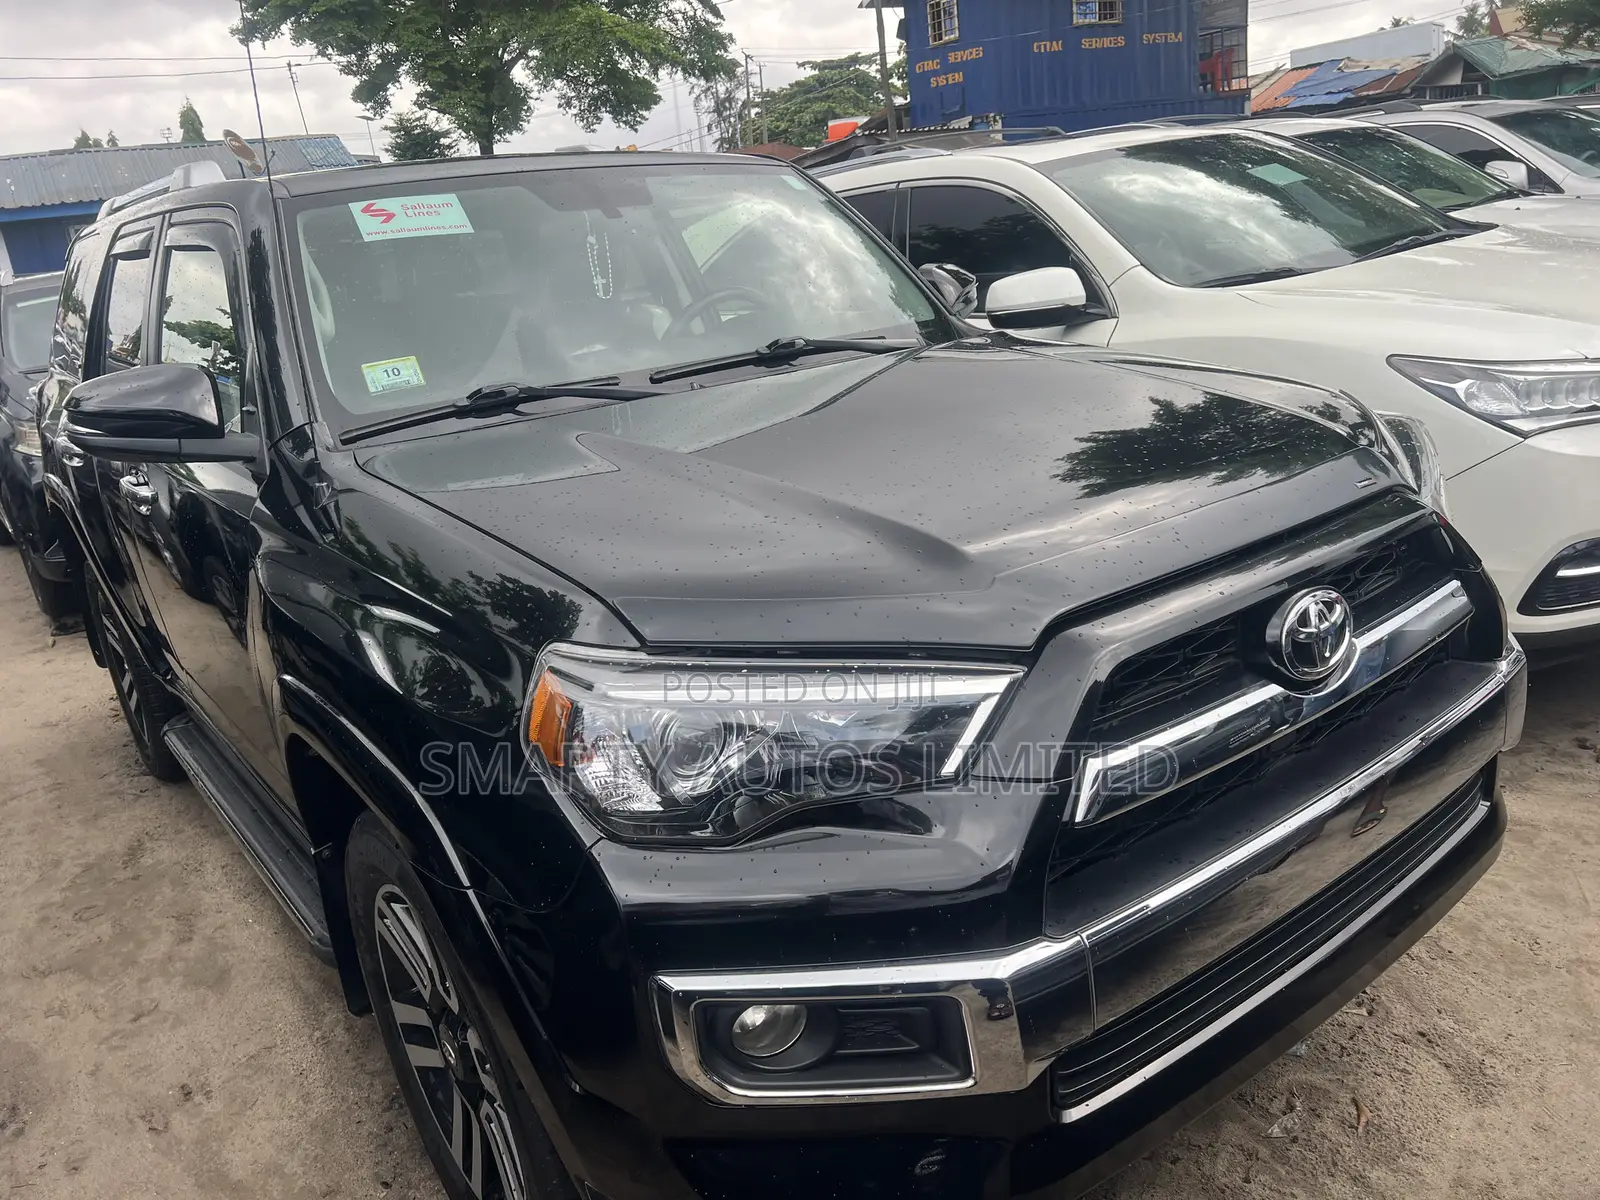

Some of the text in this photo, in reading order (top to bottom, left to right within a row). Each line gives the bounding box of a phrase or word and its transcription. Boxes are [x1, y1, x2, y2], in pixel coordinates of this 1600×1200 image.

[1081, 36, 1126, 49] SERVICES
[1142, 32, 1183, 44] SYSTEM
[400, 201, 454, 211] Sallaum
[404, 209, 441, 218] Lines
[365, 224, 468, 237] www.sallaumlines.com
[382, 367, 401, 379] 10
